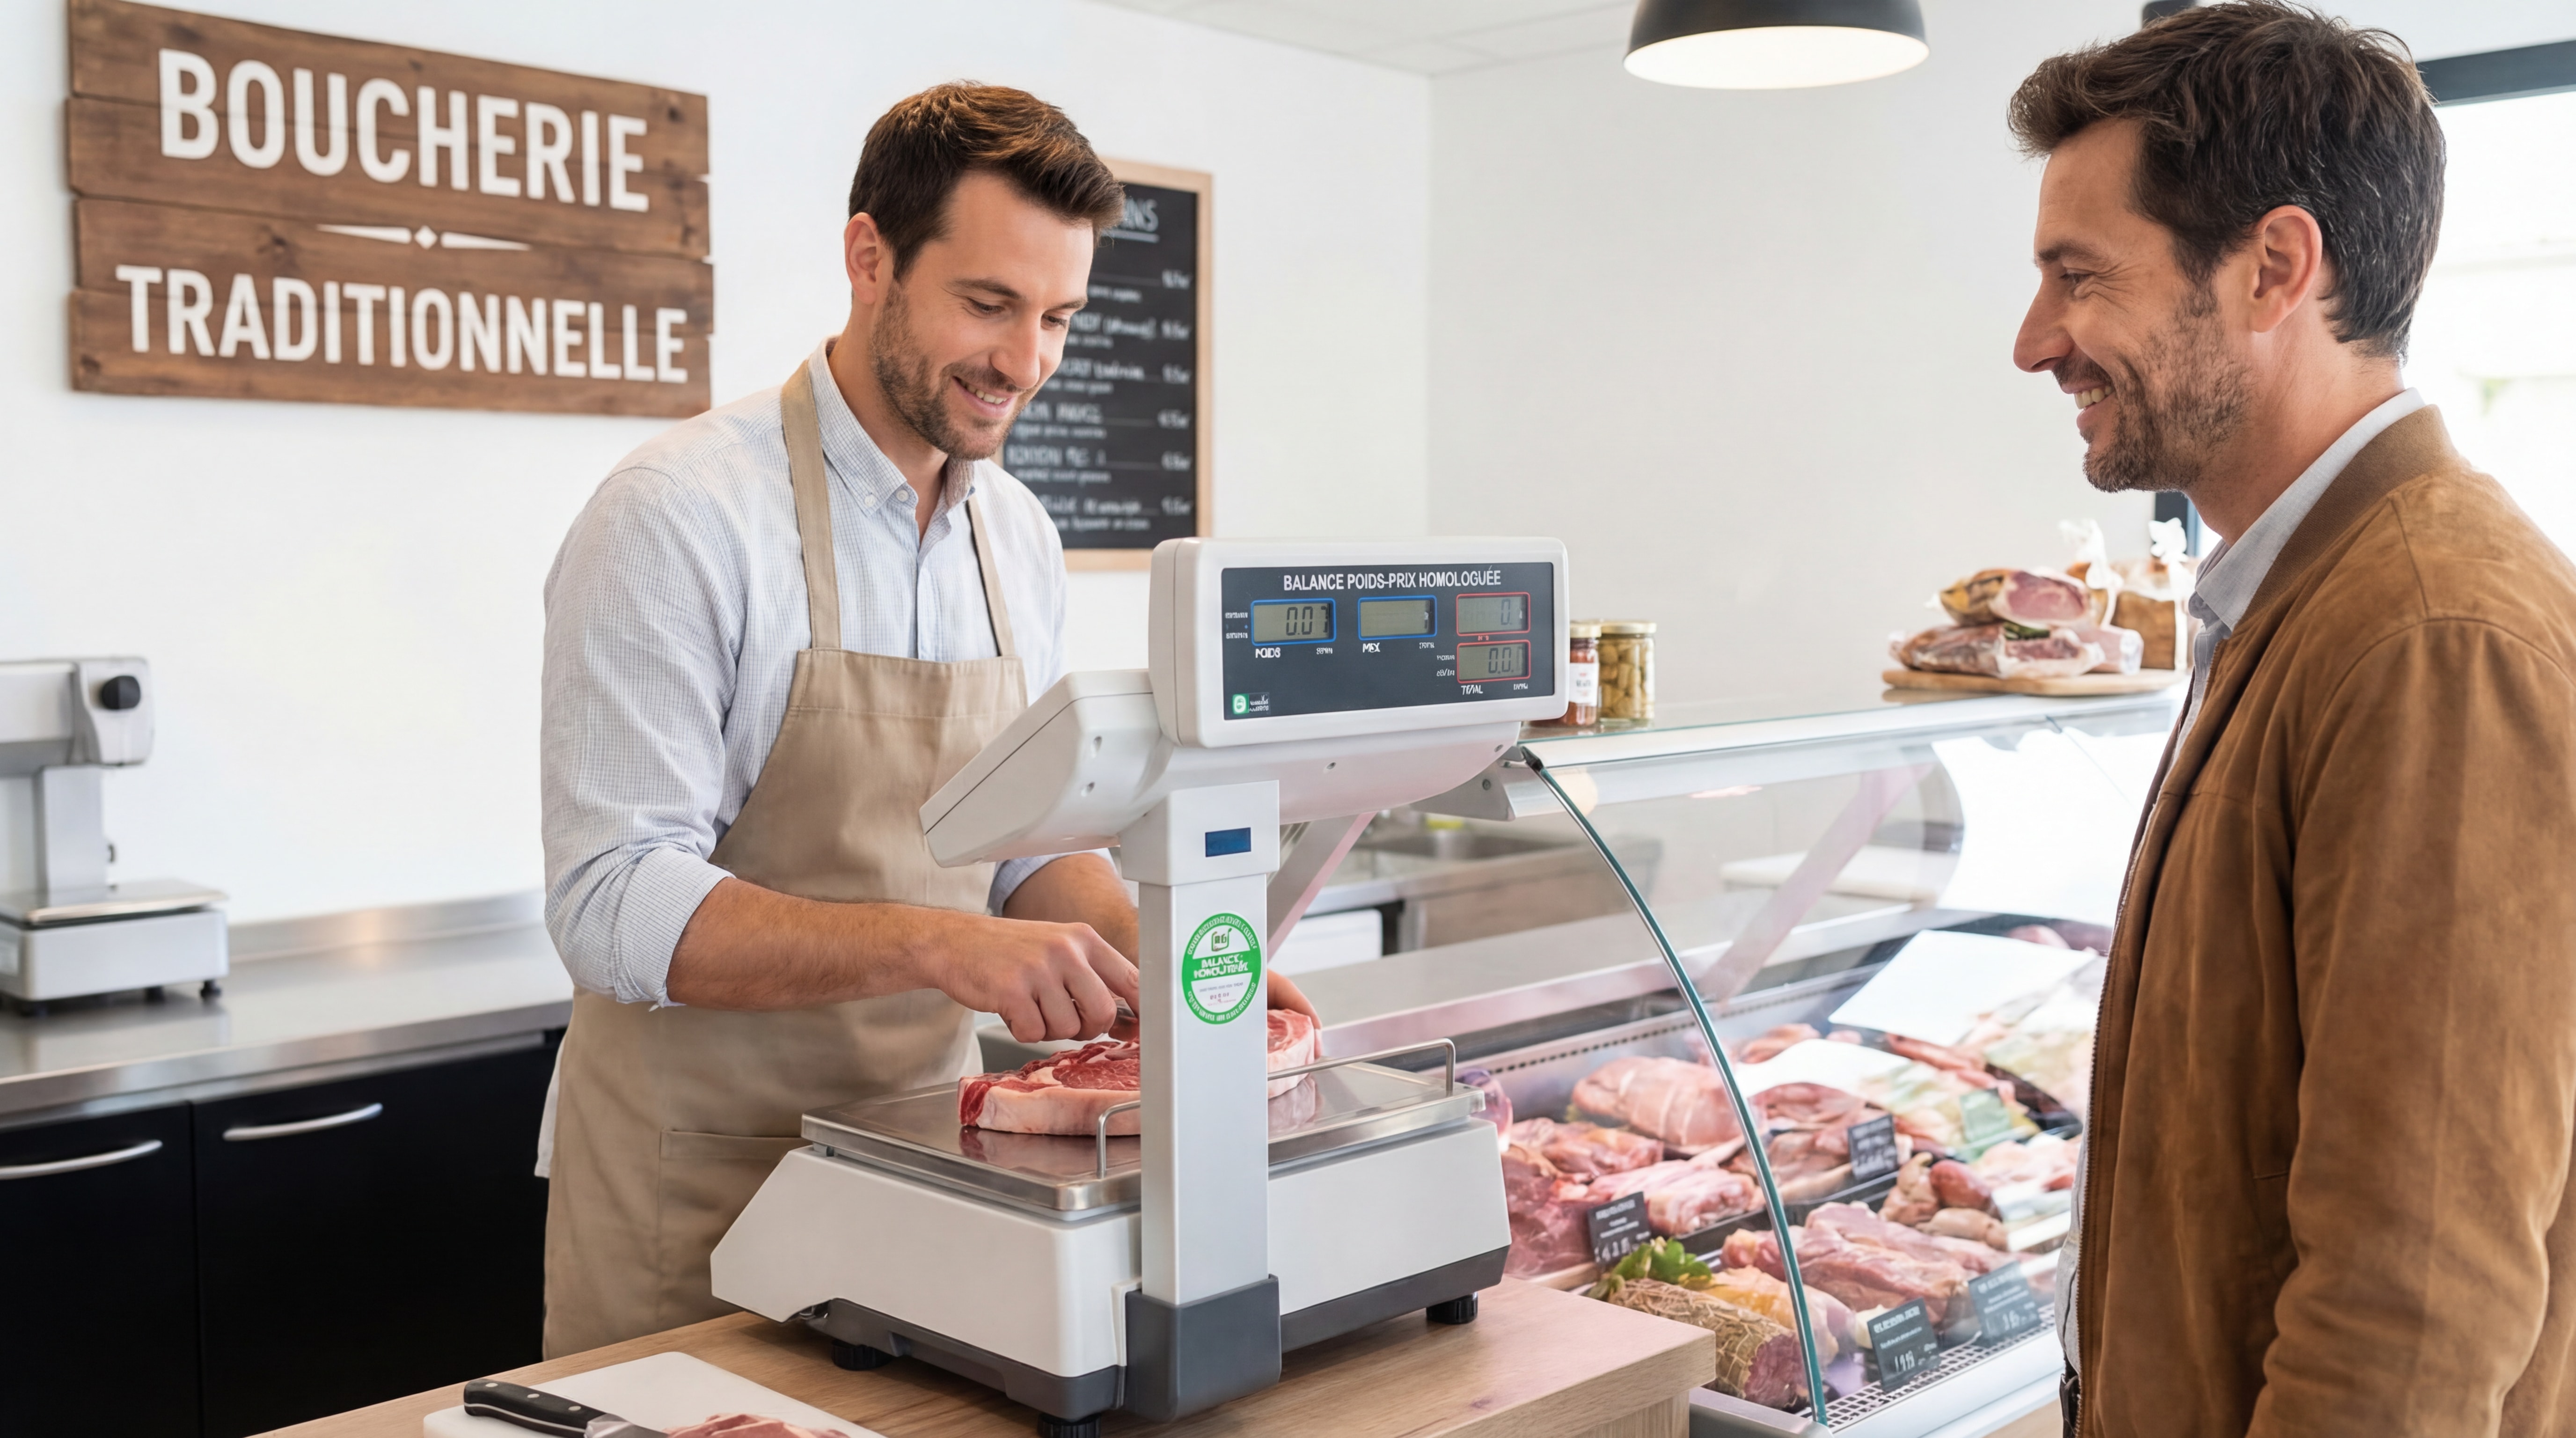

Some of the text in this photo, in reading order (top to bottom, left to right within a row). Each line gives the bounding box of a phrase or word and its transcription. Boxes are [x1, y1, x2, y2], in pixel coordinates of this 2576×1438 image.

[159, 48, 649, 212] BOUCHERIE
[116, 264, 688, 383] TRADITIONNELLE
[1284, 565, 1501, 591] BALANCE POIDS-PRIX HOMOLOGUÉE
